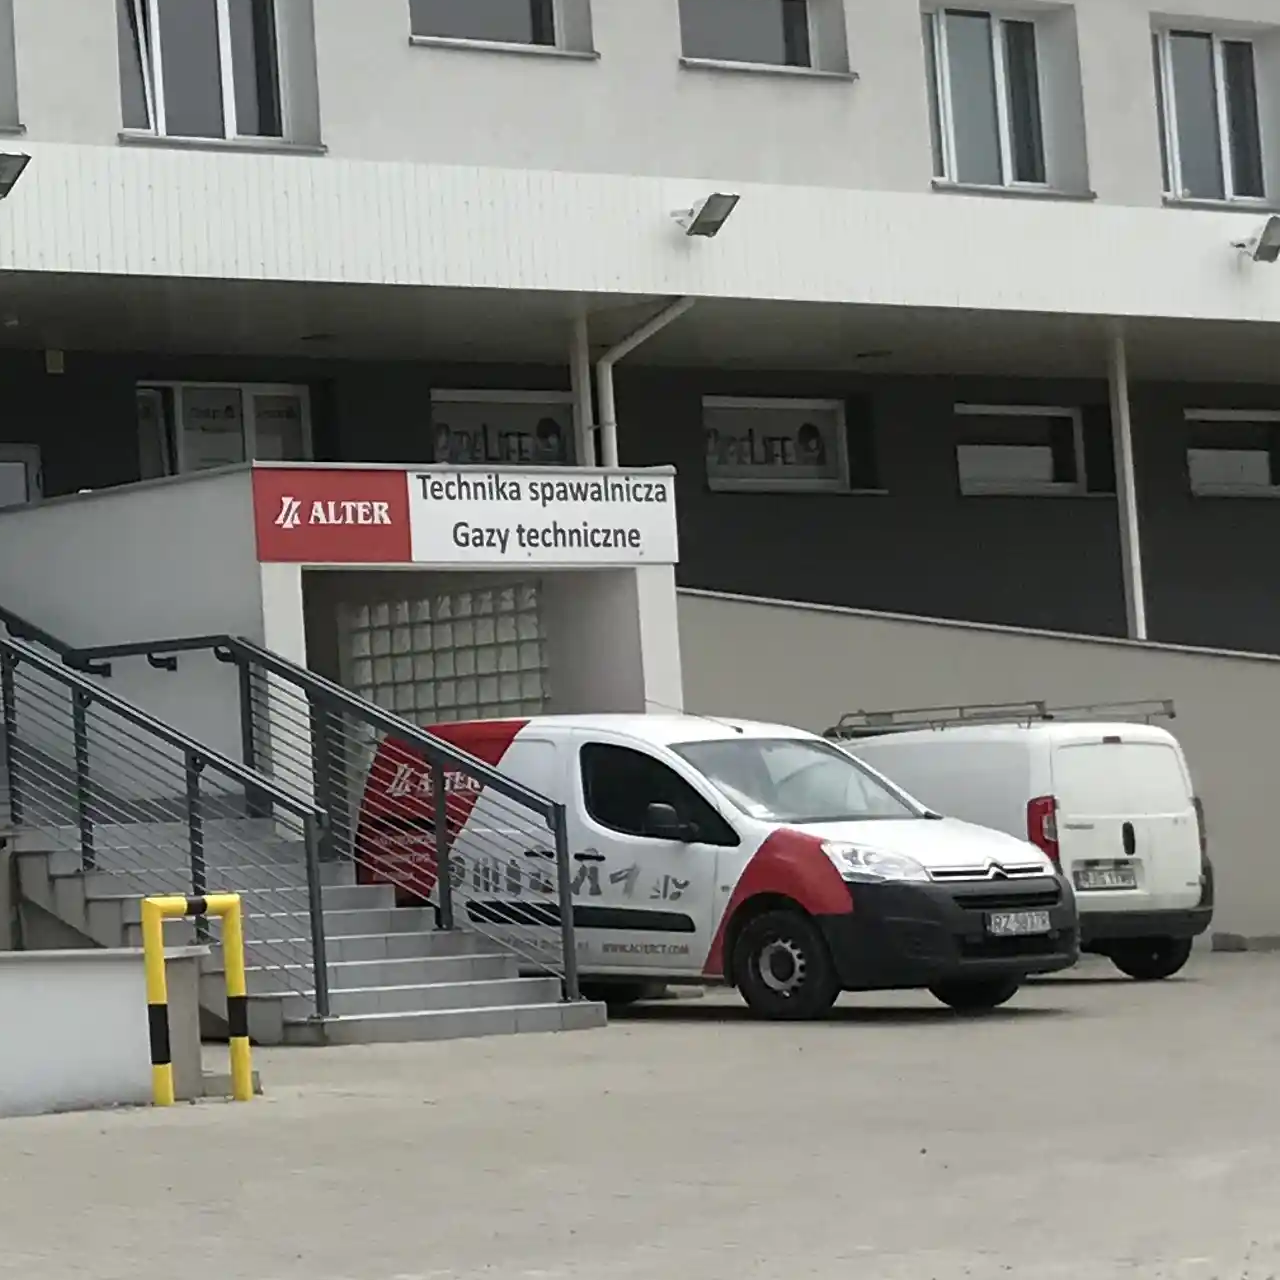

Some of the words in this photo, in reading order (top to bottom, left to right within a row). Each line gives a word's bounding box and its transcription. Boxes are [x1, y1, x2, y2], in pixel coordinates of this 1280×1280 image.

[415, 474, 522, 502] Technika
[528, 476, 667, 508] spawalnicza
[307, 500, 392, 526] ALTER
[452, 521, 509, 554] Gazy
[516, 521, 642, 549] techniczne
